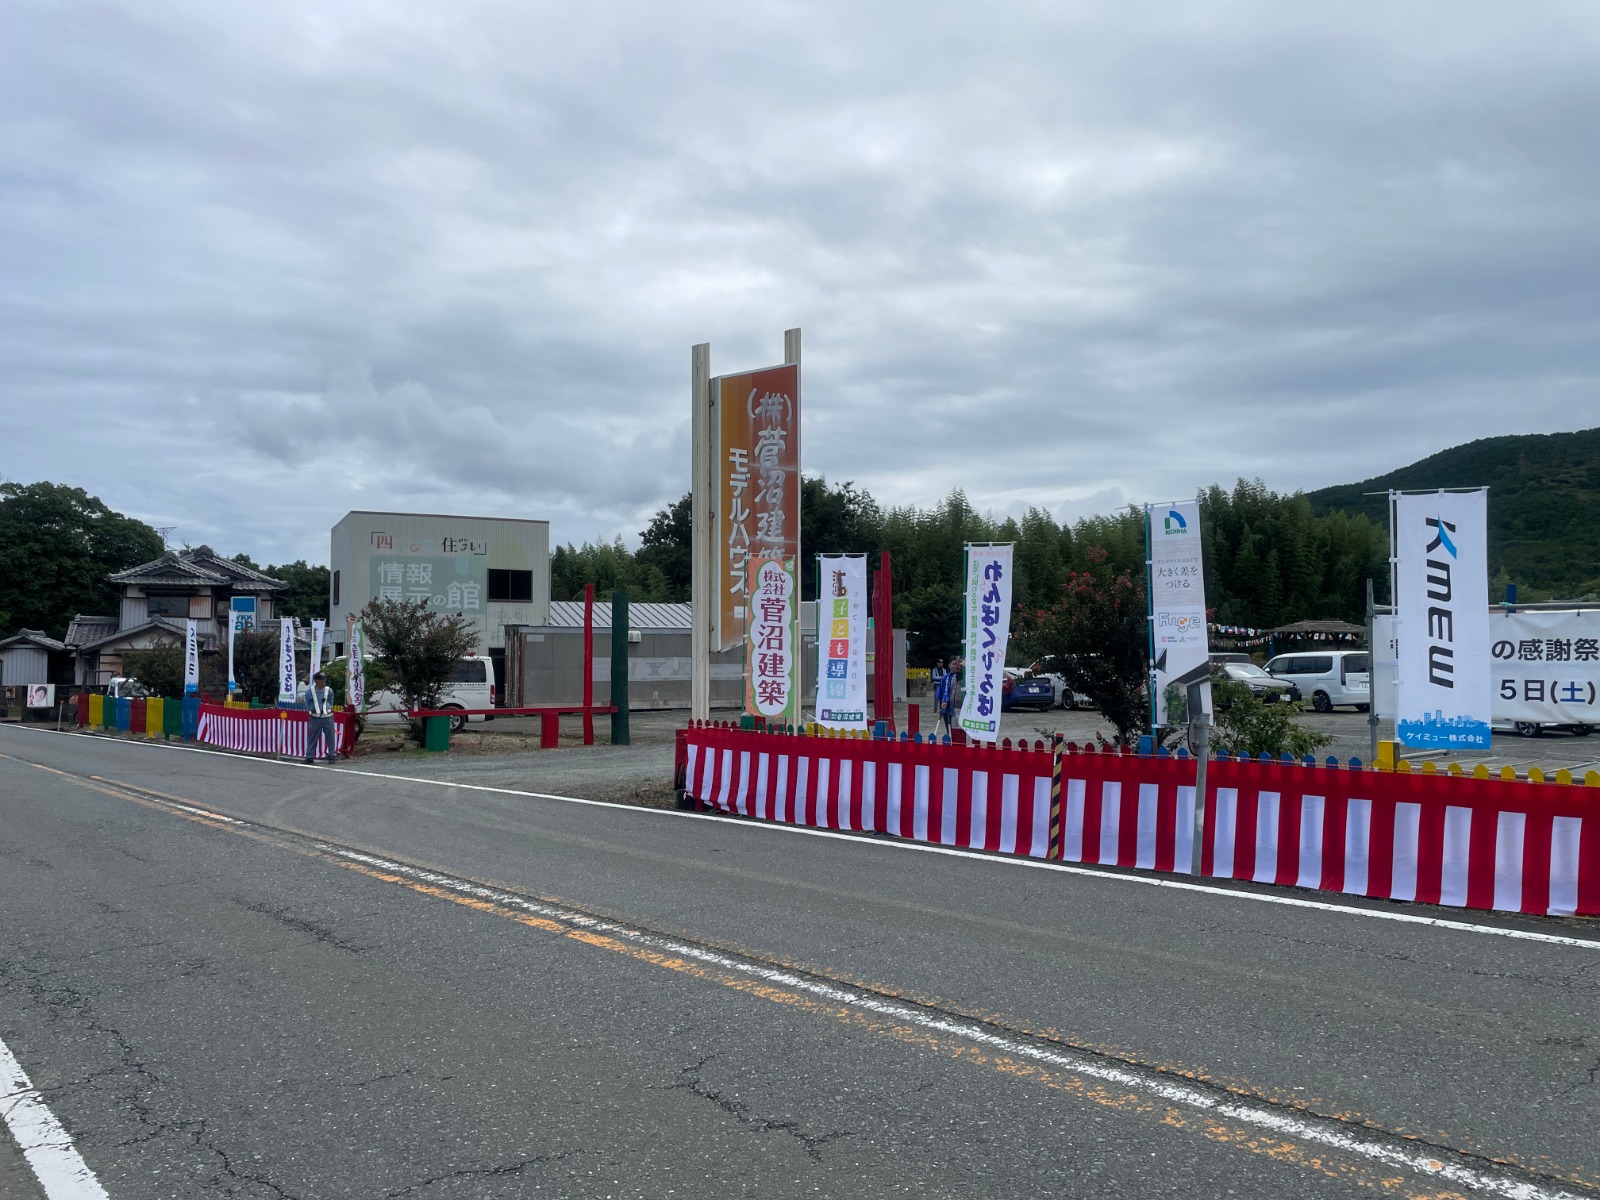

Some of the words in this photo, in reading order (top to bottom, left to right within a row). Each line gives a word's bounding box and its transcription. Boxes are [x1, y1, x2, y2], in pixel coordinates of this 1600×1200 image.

[728, 447, 752, 594] モデルハウス
[377, 561, 432, 584] 情報
[1156, 566, 1199, 578] 大きく差を
[1165, 579, 1190, 589] つける
[757, 597, 787, 706] 菅沼建築
[1491, 638, 1600, 662] の感謝祭
[1499, 679, 1596, 705] 5日(土)
[1406, 732, 1484, 744] ケイミュー株式会社
